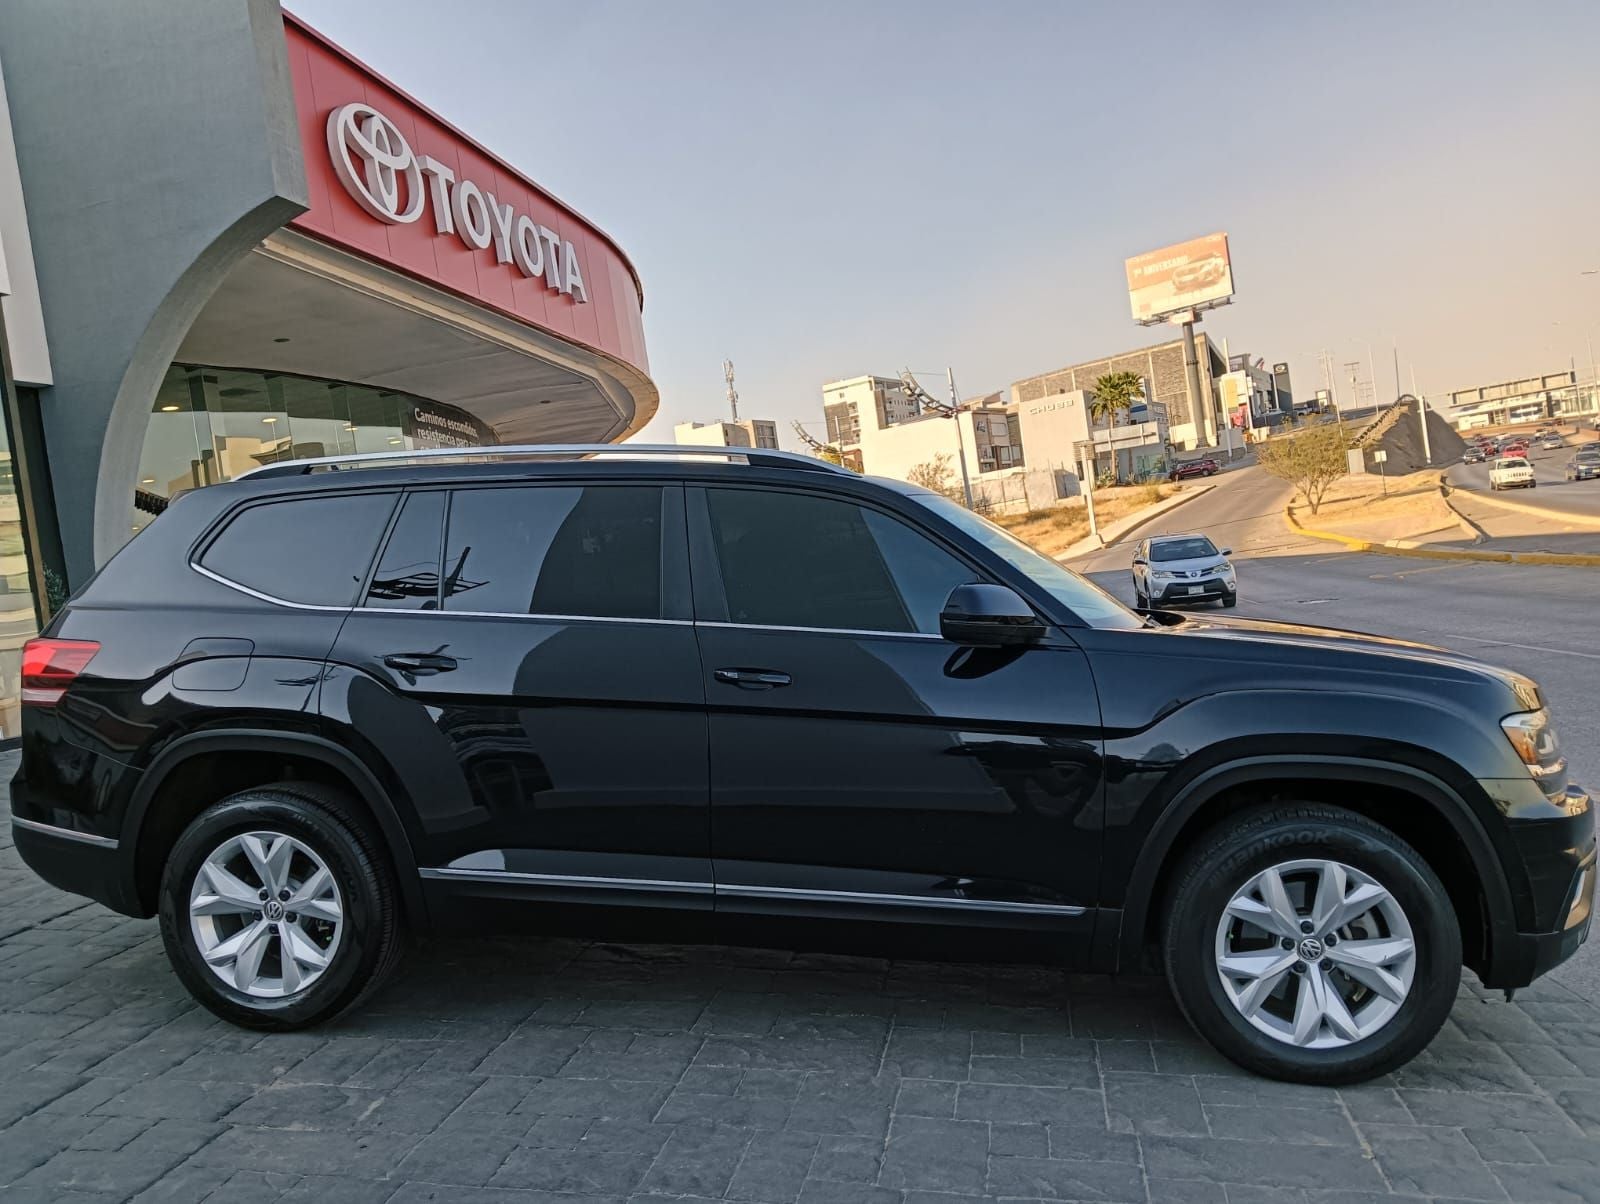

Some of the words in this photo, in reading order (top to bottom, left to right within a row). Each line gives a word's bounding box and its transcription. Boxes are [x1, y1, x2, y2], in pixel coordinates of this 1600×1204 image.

[420, 154, 587, 304] TOYOTA
[414, 407, 447, 427] Caminos
[417, 427, 456, 446] resistencia
